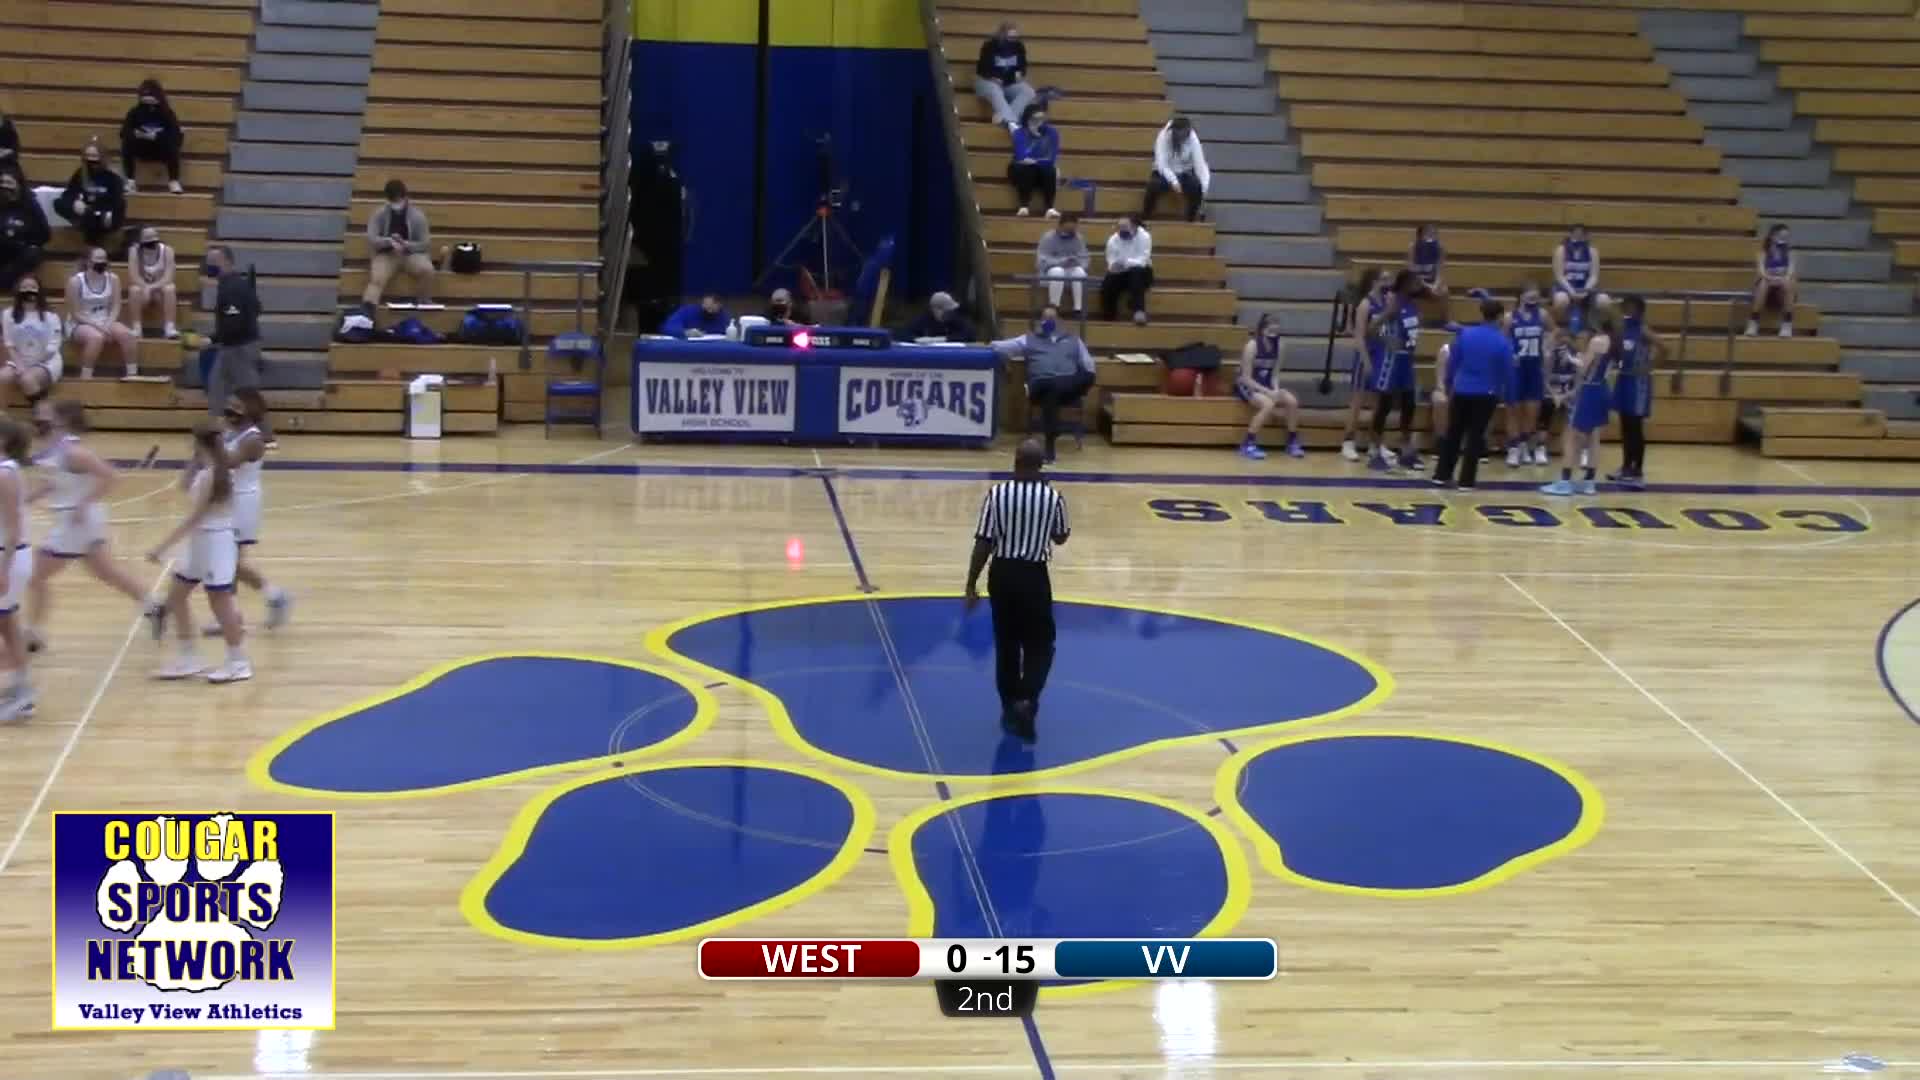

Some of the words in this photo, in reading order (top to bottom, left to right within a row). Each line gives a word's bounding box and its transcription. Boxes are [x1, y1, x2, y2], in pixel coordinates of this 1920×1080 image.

[645, 378, 725, 415] VALLEY
[733, 378, 790, 416] VIEW
[846, 378, 986, 425] COUGARS
[1147, 498, 1870, 532] COUGARS
